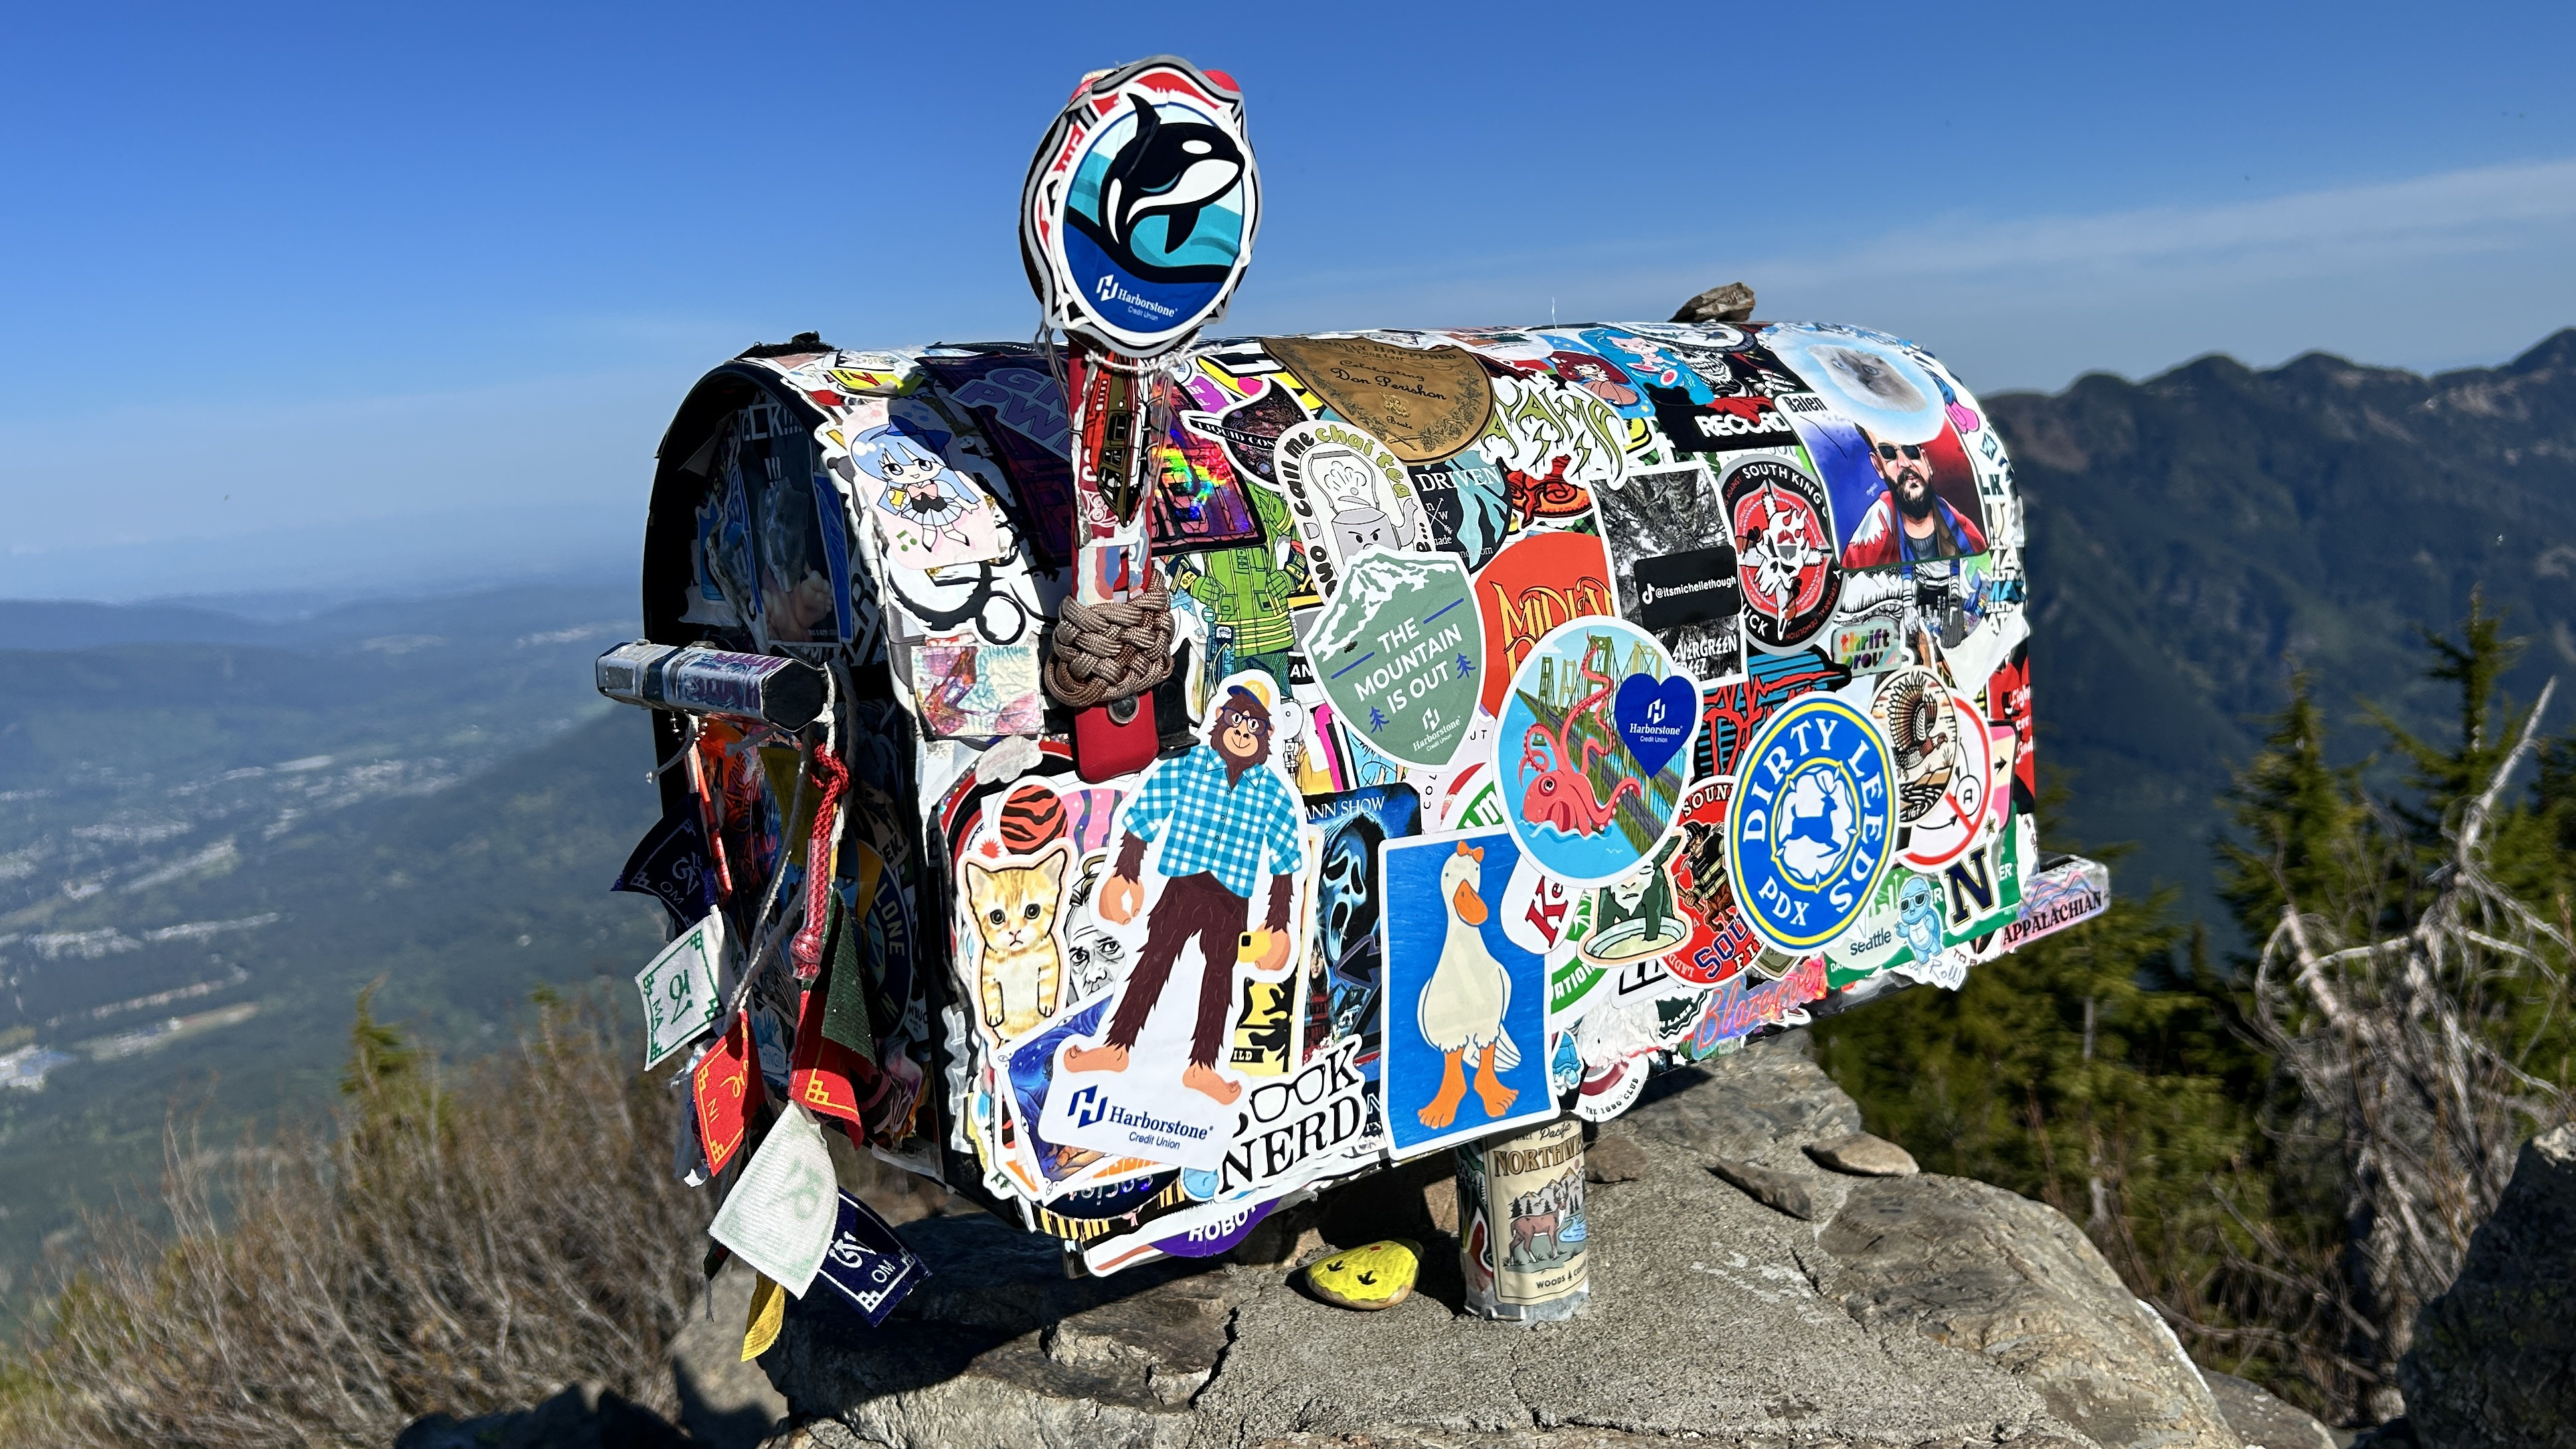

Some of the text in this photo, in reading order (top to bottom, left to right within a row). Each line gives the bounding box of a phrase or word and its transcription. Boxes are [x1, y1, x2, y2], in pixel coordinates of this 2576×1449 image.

[1118, 288, 1175, 317] Harborstone
[1128, 305, 1159, 321] Credit Union
[1330, 367, 1371, 384] Don
[1339, 360, 1426, 381] Celebrating
[1782, 396, 1828, 413] Balen
[1197, 422, 1245, 442] LIQUID
[1284, 432, 1314, 458] me
[1315, 424, 1375, 457] chai
[1282, 460, 1313, 518] call
[1376, 452, 1412, 499] tea
[1415, 467, 1502, 492] DRIVEN
[1743, 464, 1822, 503] SOUTH KING
[1655, 575, 1737, 599] @itsmichellethough
[1377, 617, 1420, 653] THE
[1672, 635, 1737, 663] EVERGREEN
[1841, 628, 1890, 653] thrift
[1354, 624, 1462, 701] MOUNTAIN
[1387, 661, 1450, 714] IS OUT
[1413, 716, 1460, 752] Harborstone
[1426, 733, 1453, 752] Credit Union
[1630, 723, 1681, 736] Harborstone
[1341, 796, 1386, 817] SHOW
[1681, 783, 1734, 817] SOUN
[1743, 718, 1884, 913] DIRTY LEEDS
[660, 881, 685, 905] OM
[1944, 843, 1995, 928] N
[1759, 875, 1810, 926] PDX
[2003, 890, 2103, 946] APPALACHIAN
[1667, 1005, 1693, 1025] LAKE
[1586, 1104, 1597, 1116] THE
[1624, 1077, 1639, 1100] CLUB
[1108, 1105, 1208, 1140] Harborstone
[1129, 1131, 1181, 1151] Credit Union
[1219, 1096, 1360, 1195] NERD
[871, 1260, 896, 1284] OM
[1535, 1275, 1566, 1288] WOODS
